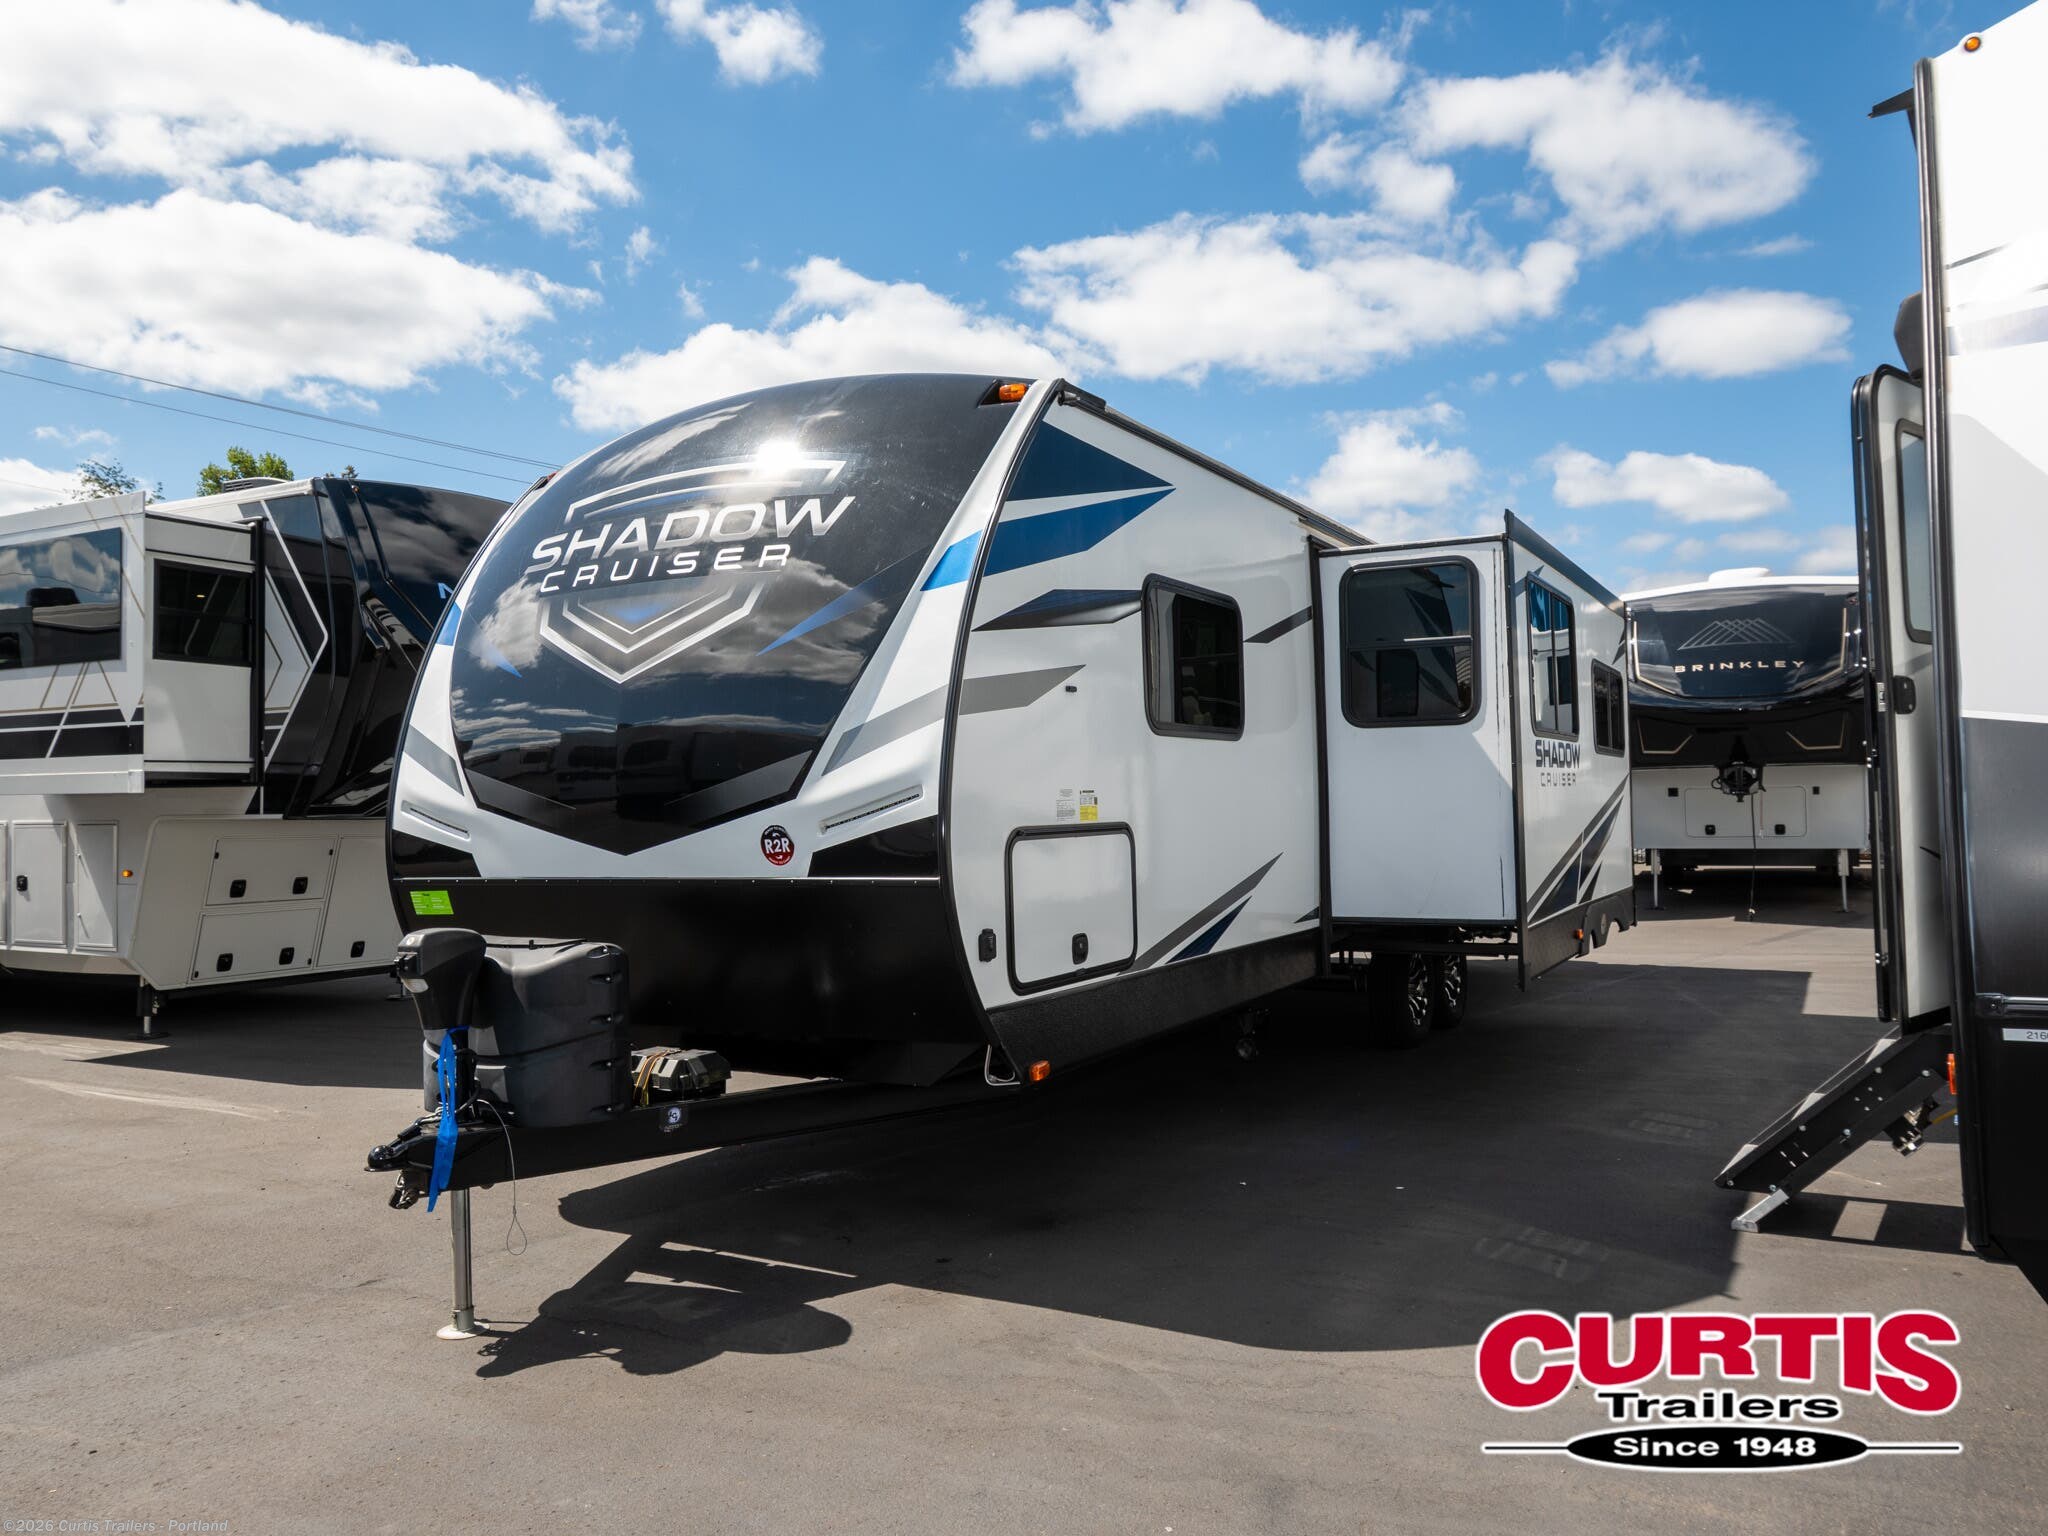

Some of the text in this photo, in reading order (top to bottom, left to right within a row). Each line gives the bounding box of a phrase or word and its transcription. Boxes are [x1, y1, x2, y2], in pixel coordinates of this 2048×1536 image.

[524, 496, 856, 574] SHADOW
[540, 543, 791, 593] CRUISER
[1674, 660, 1805, 673] BRINKLEY
[1535, 739, 1580, 769] SHADOW
[1540, 772, 1577, 787] CRUISER
[764, 837, 791, 854] R2R
[2026, 1031, 2048, 1041] 216
